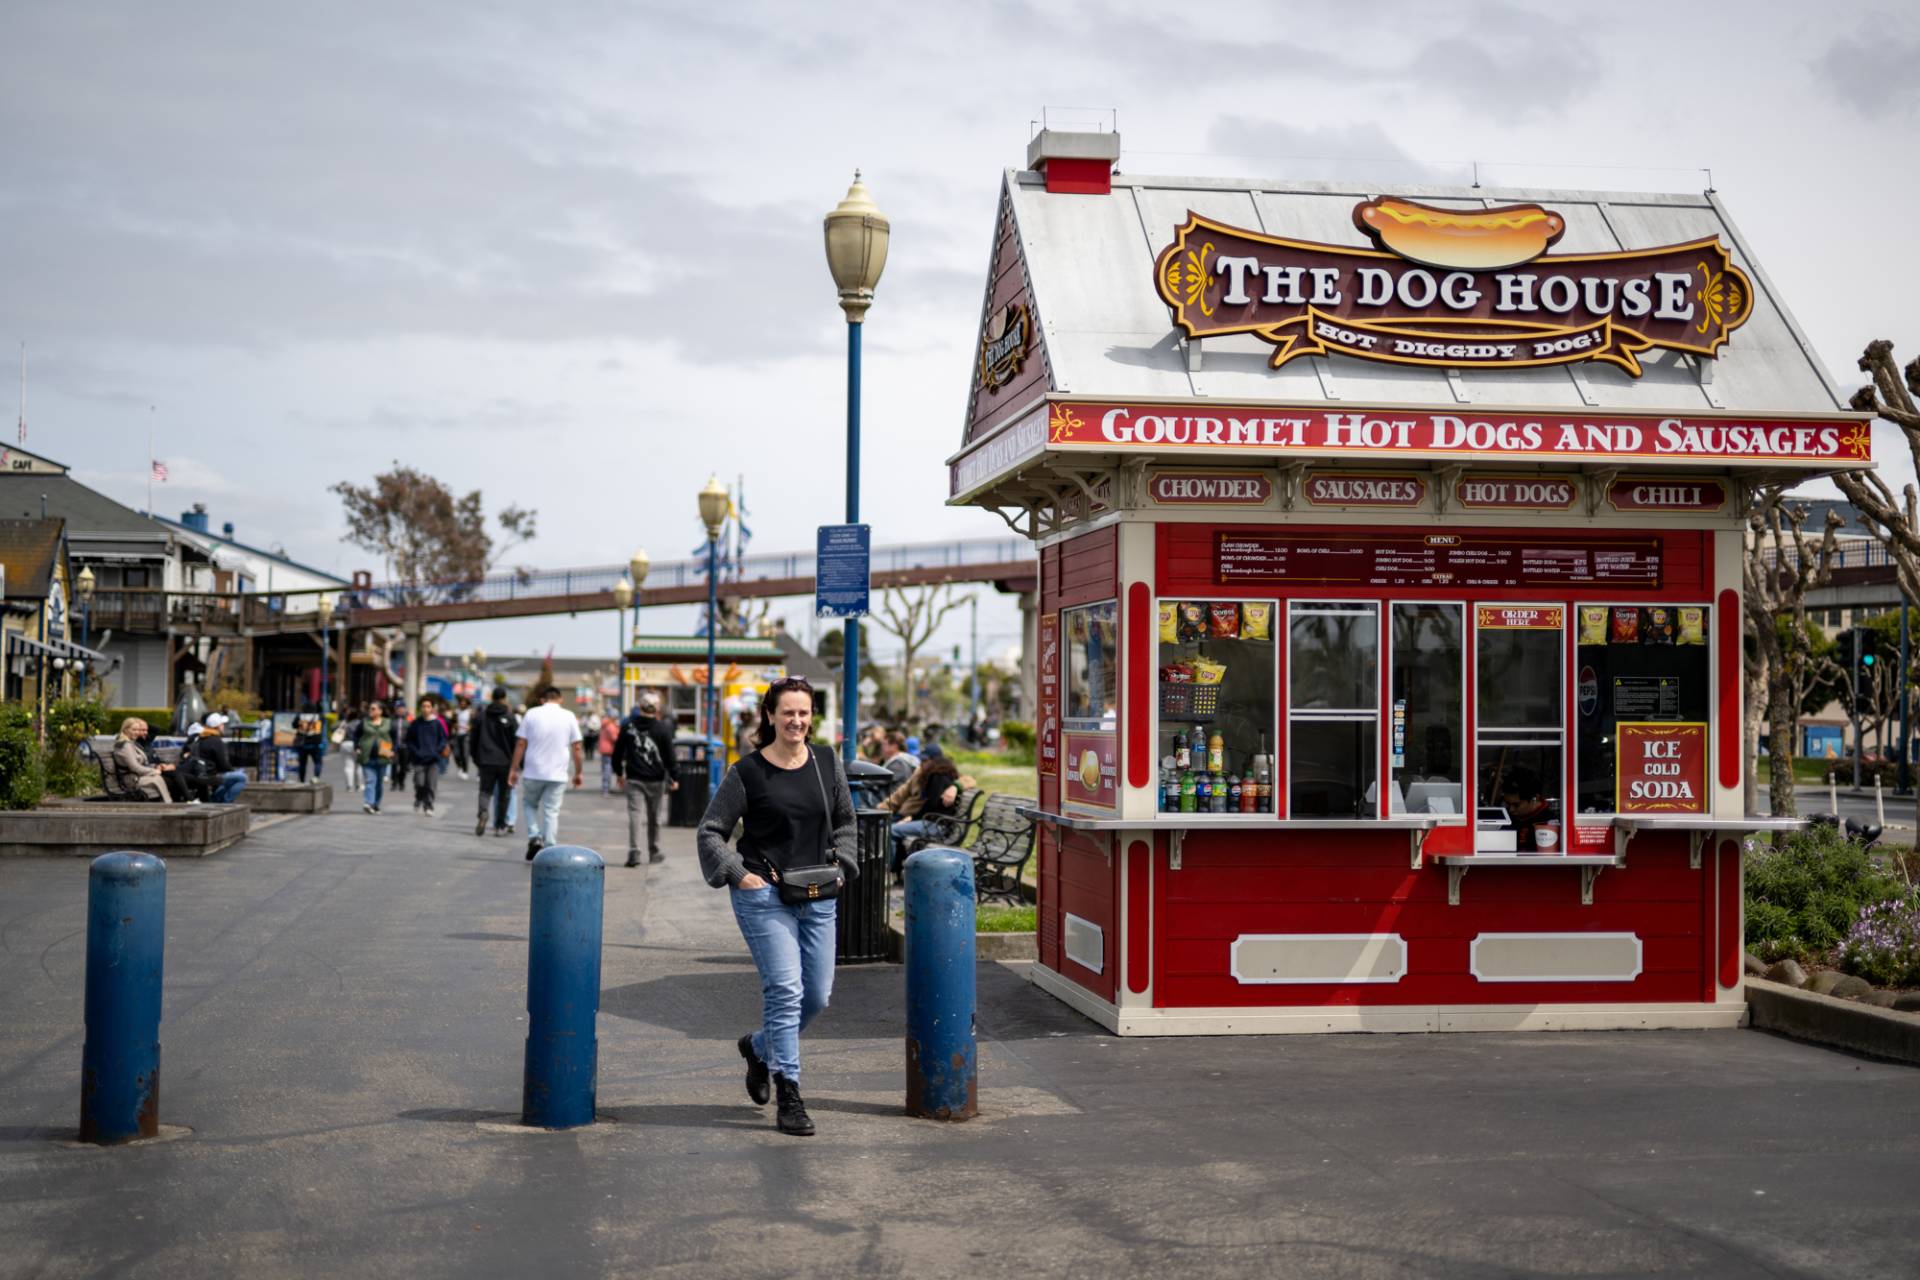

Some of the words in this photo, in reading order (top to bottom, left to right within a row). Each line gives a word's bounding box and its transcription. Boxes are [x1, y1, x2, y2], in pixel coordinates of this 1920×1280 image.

[1216, 255, 1342, 305] THE
[1357, 268, 1482, 310] DOG
[1495, 272, 1695, 321] HOUSE
[1315, 322, 1378, 349] HOT
[1395, 339, 1517, 358] DIGGIDY
[1533, 329, 1602, 356] DOG!
[1101, 407, 1311, 448] GOURMET
[1323, 414, 1417, 447] HOT
[1429, 416, 1543, 450] DOGS
[1554, 423, 1643, 452] AND
[1654, 418, 1840, 456] SAUSAGES
[1158, 479, 1262, 499] CHOWDER
[1313, 480, 1418, 501] SAUSAGES
[1464, 483, 1510, 503] HOT
[1514, 484, 1570, 504] DOGS
[1632, 486, 1703, 506] CHILI
[1430, 536, 1455, 544] MENU
[1502, 610, 1539, 620] ORDER
[1506, 618, 1532, 626] HERE
[1643, 740, 1682, 760] ICE
[1644, 763, 1680, 775] COLD
[1629, 780, 1694, 799] SODA
